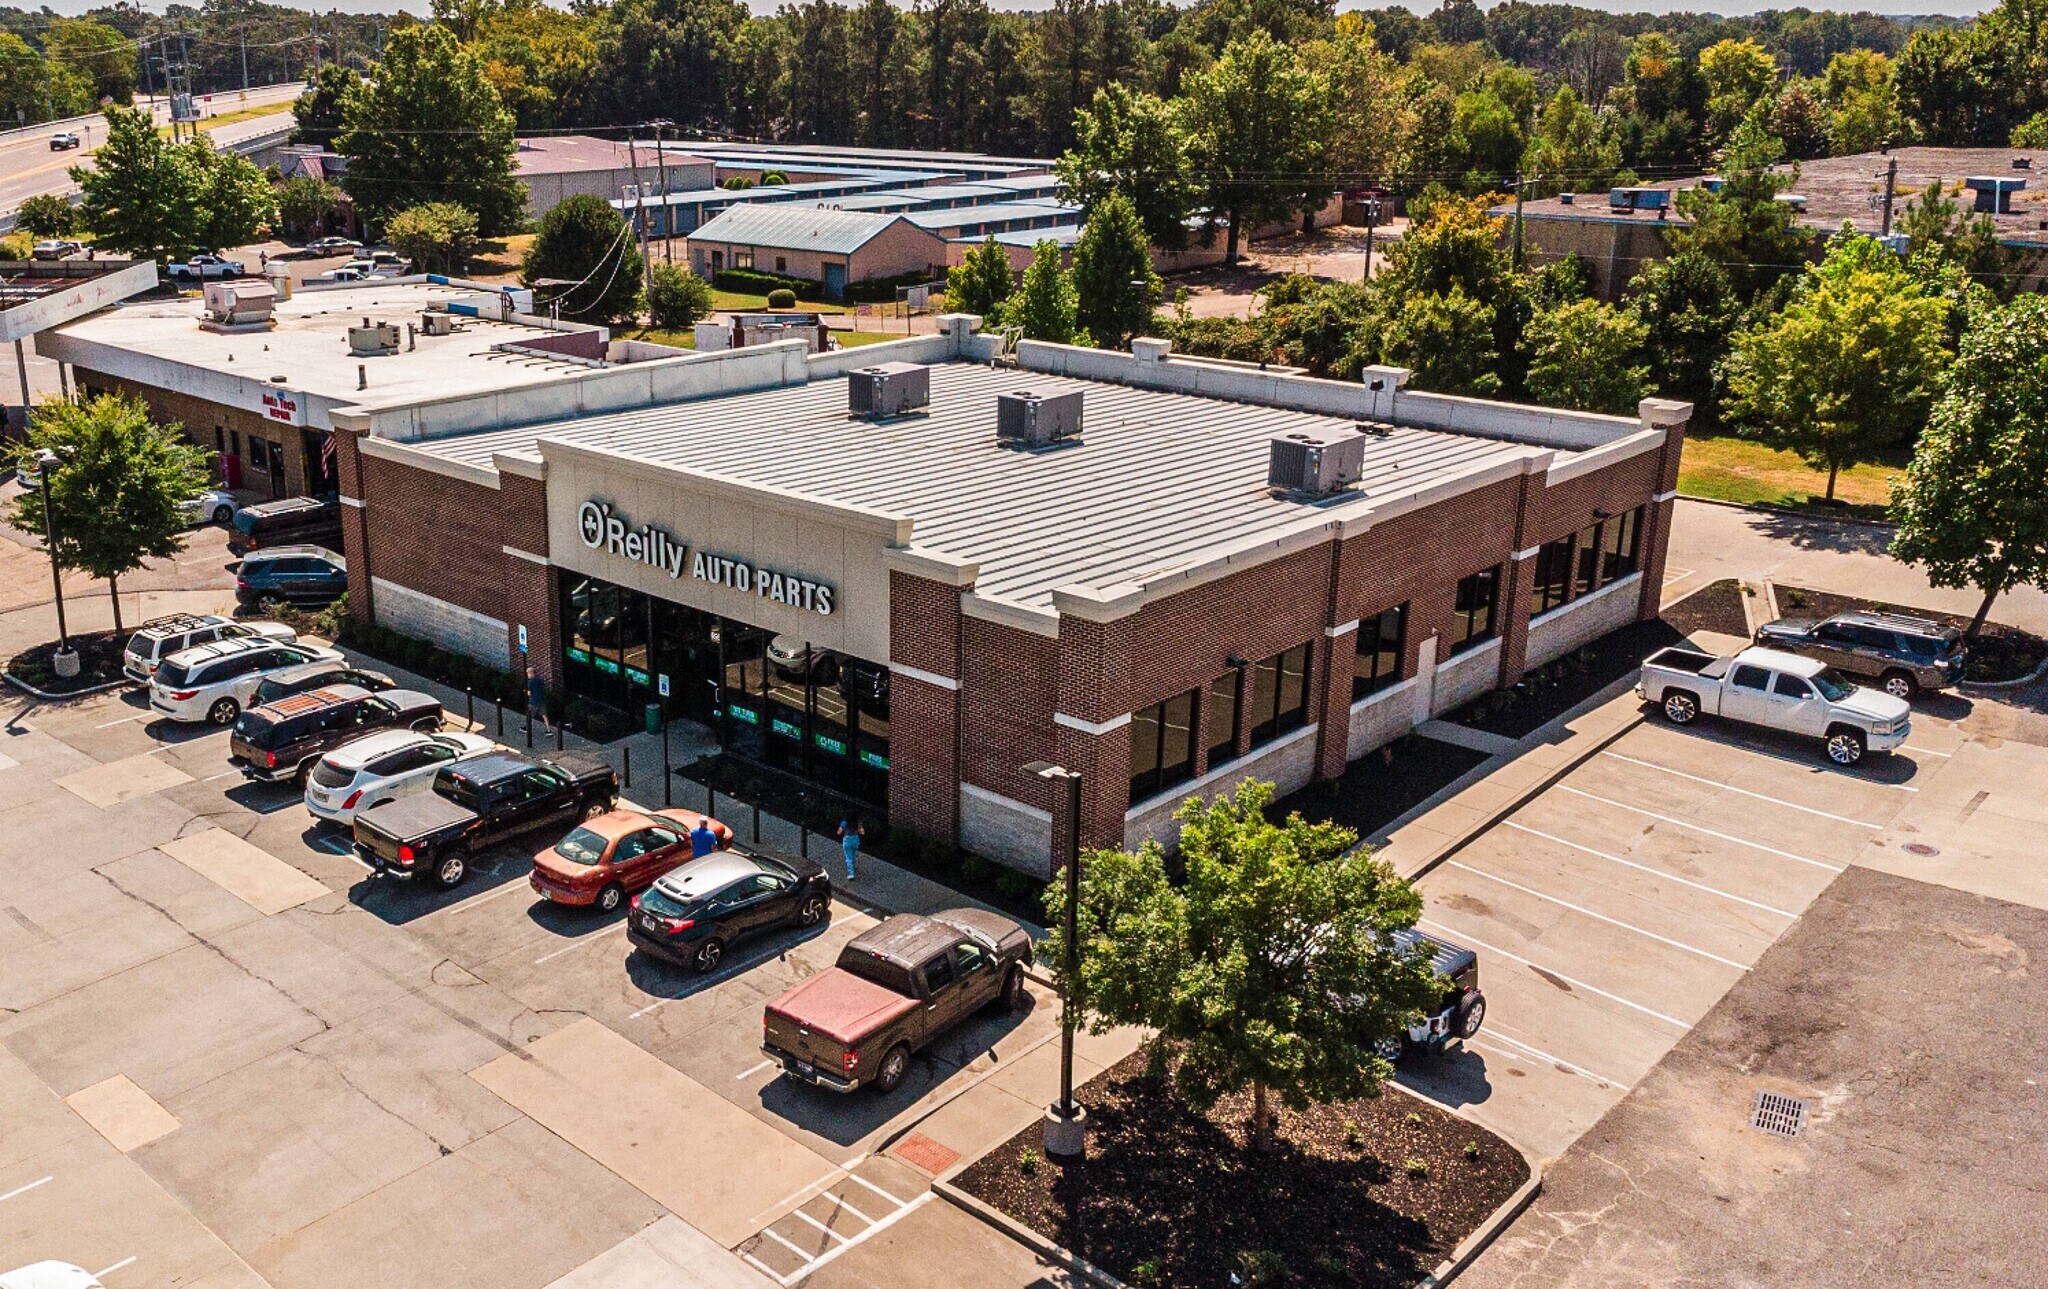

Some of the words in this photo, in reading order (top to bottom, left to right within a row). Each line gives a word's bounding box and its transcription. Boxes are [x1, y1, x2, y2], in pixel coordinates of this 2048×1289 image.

[578, 500, 686, 579] O'Reilly
[693, 552, 751, 592] AUTO
[757, 569, 834, 616] PARTS
